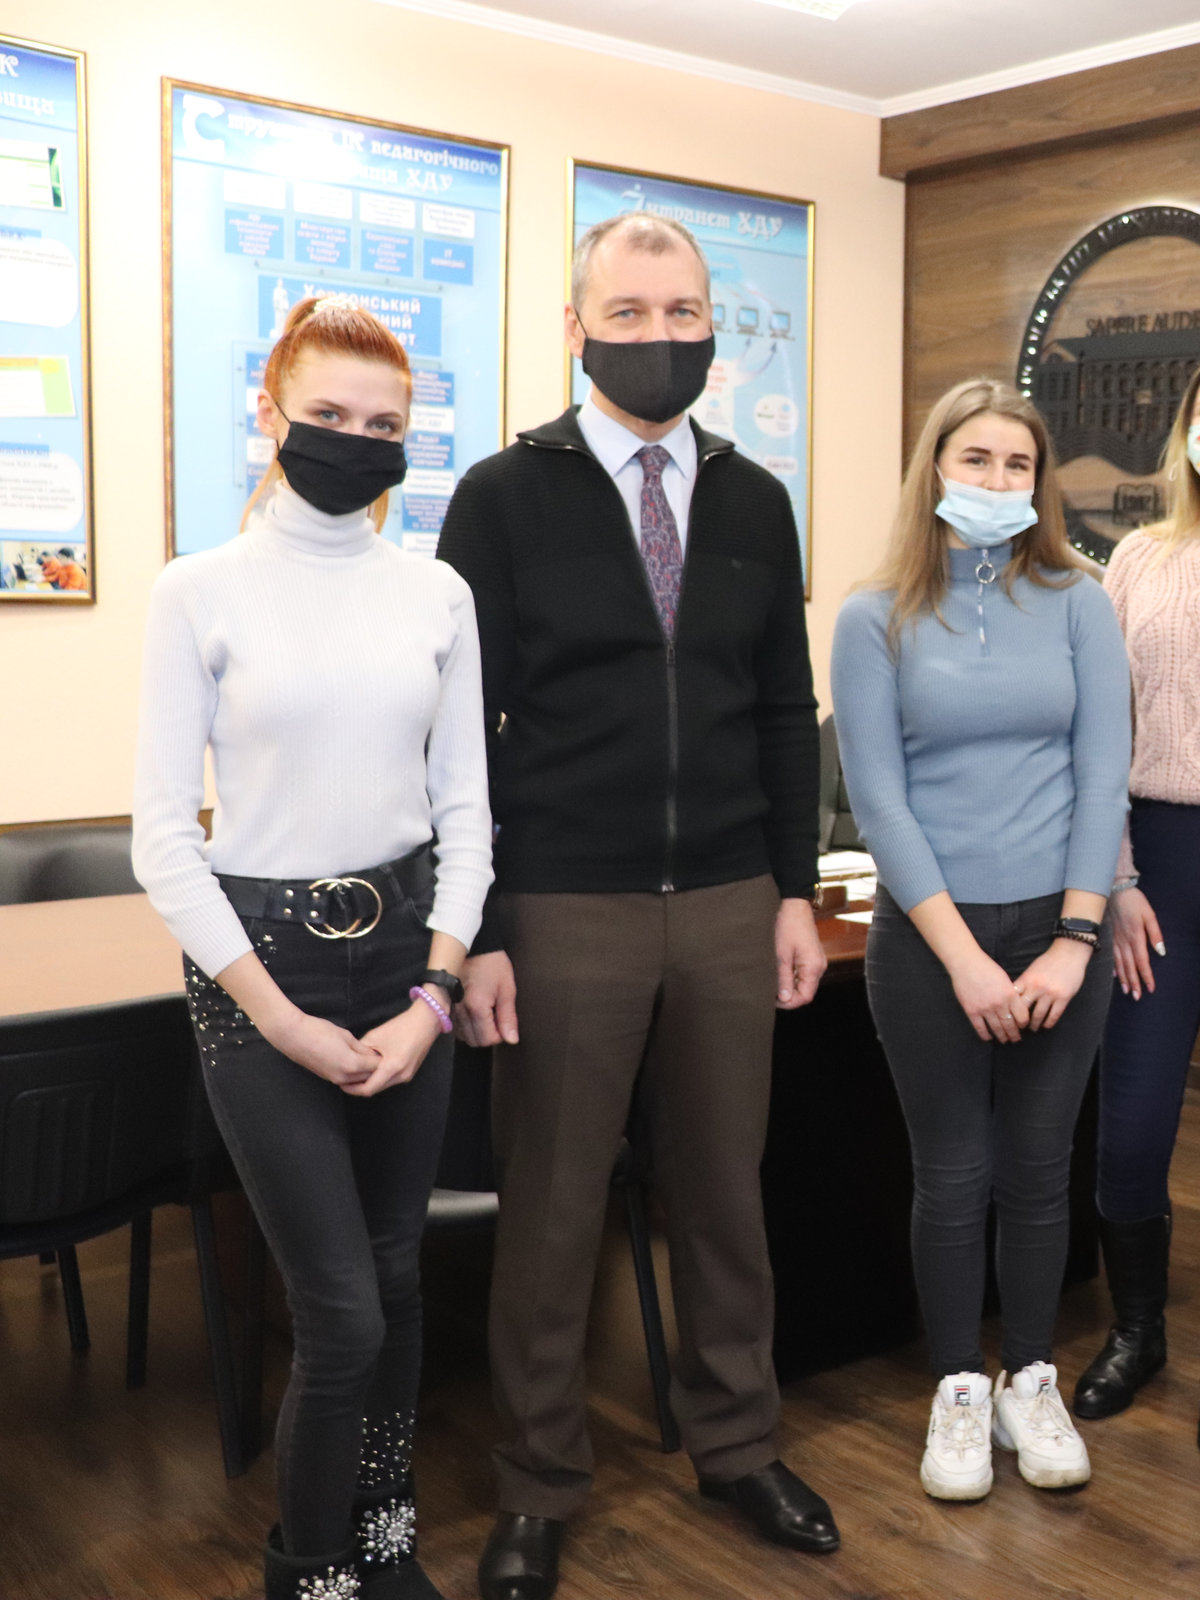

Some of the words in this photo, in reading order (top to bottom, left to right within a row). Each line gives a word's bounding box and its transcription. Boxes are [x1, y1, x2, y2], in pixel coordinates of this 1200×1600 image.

[371, 140, 499, 176] педагогічного
[405, 168, 454, 194] ХДУ
[736, 211, 784, 240] ХДУ
